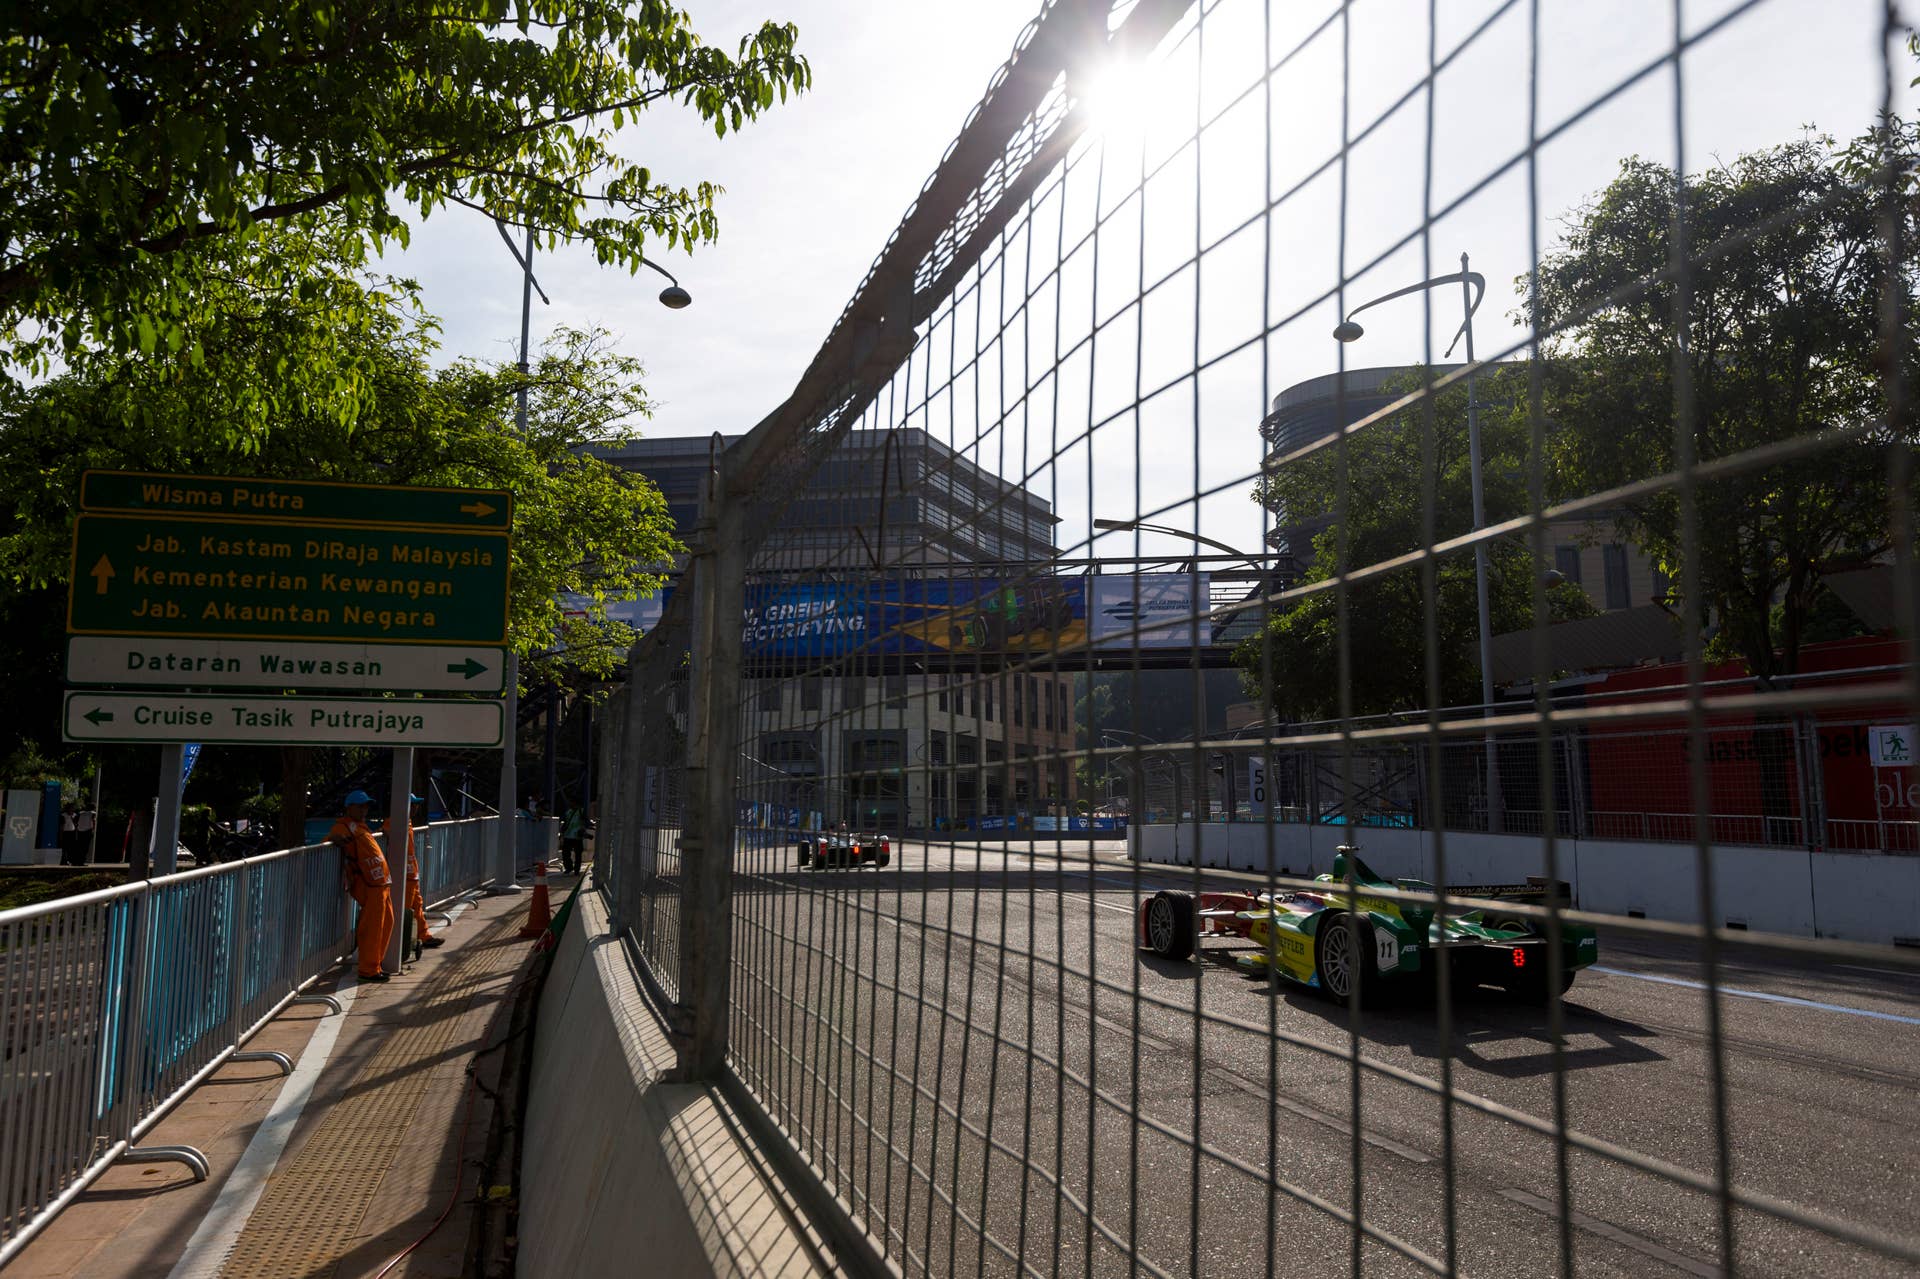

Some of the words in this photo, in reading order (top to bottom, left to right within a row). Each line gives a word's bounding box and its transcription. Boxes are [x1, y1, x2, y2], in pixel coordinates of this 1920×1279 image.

[142, 483, 223, 506] Wisma
[232, 488, 304, 510] Putra
[135, 533, 187, 555] Jab.
[200, 536, 293, 560] Kastam
[305, 540, 379, 567] DiRaja
[391, 543, 494, 569] Malaysia
[133, 565, 308, 592] Kementerian
[320, 573, 453, 598] Kewangan
[131, 598, 189, 620] Jab.
[202, 600, 331, 625] Akauntan
[343, 605, 436, 631] Negara
[128, 652, 241, 673] Dataran
[261, 655, 383, 676] Wawasan
[135, 705, 213, 726] Cruise
[232, 707, 294, 728] Tasik
[311, 709, 425, 733] Putrajaya
[1255, 770, 1265, 801] 50
[1380, 941, 1393, 958] 11
